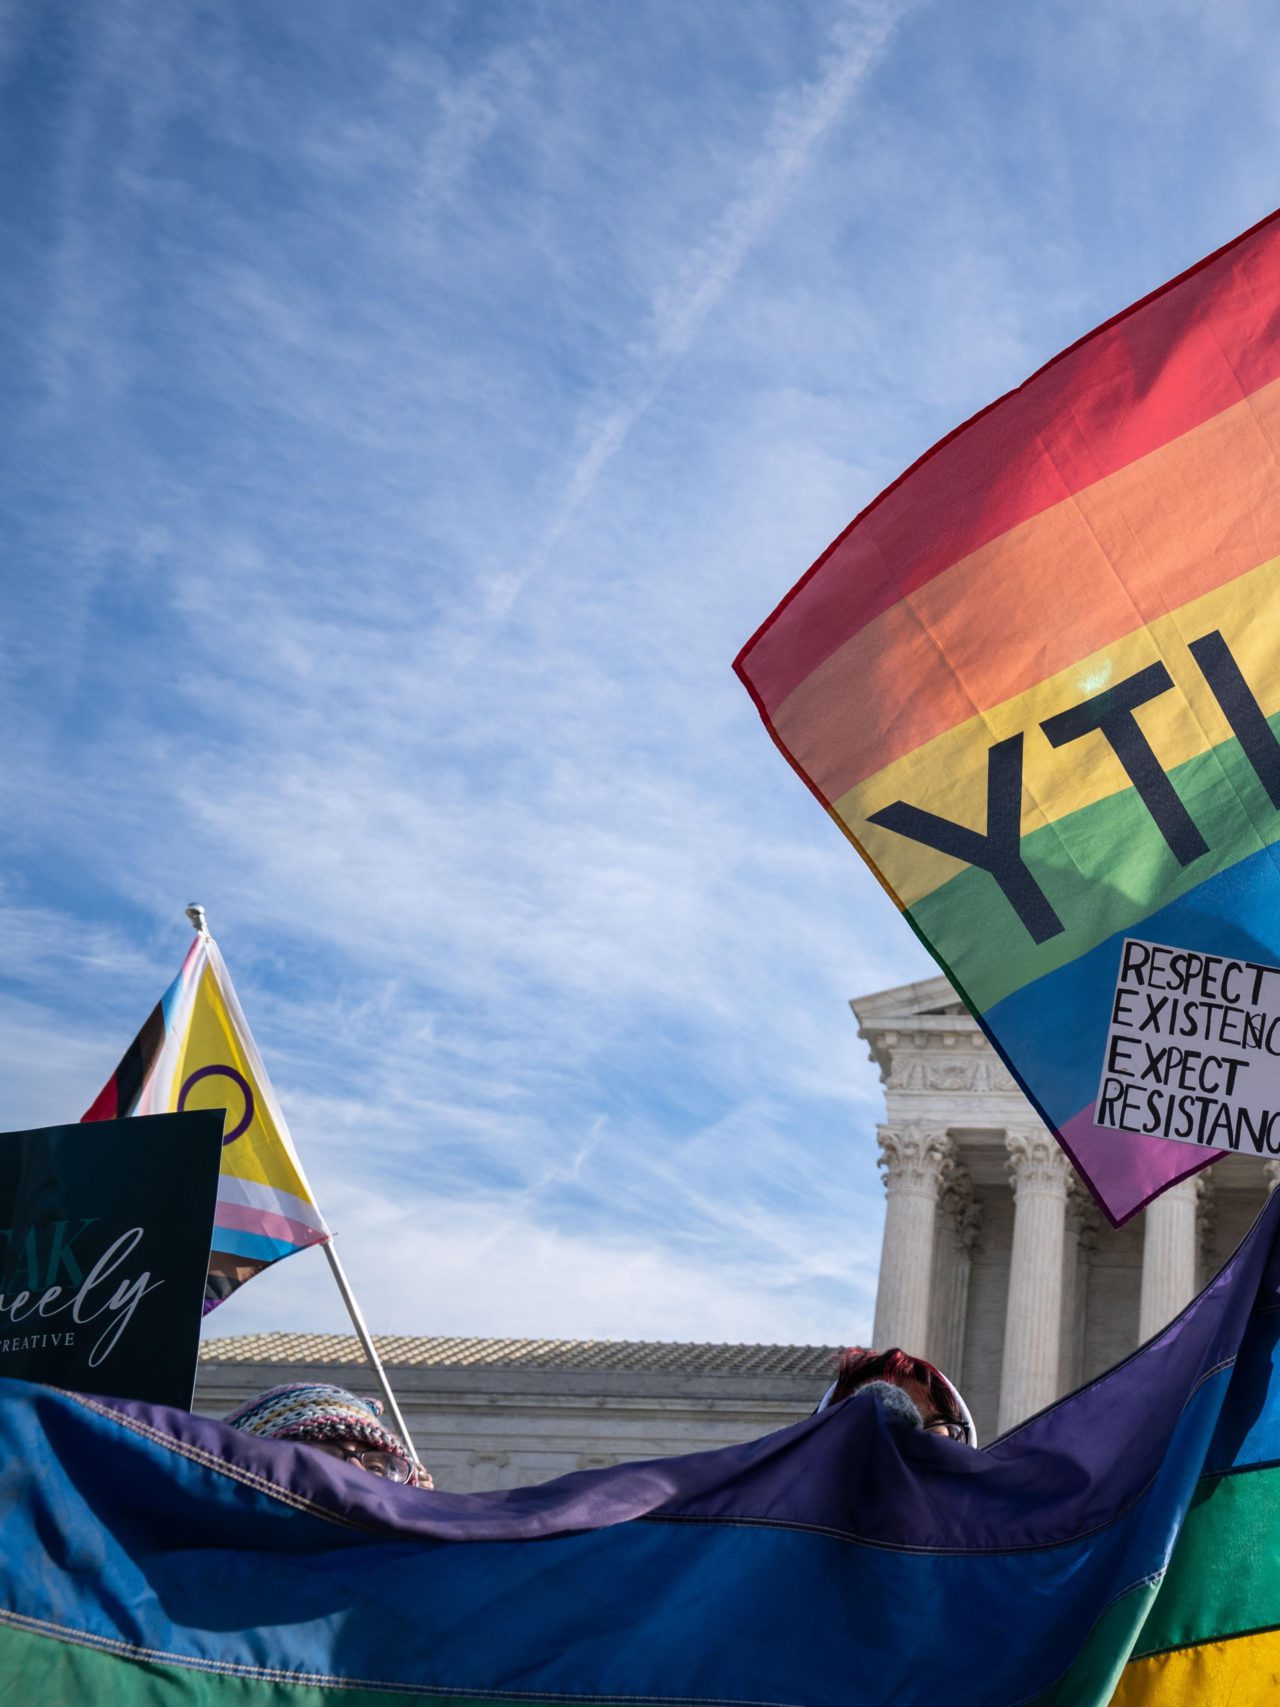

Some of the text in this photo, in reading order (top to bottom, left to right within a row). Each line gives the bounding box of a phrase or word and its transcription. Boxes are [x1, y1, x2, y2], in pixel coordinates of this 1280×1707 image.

[1120, 941, 1280, 1006] RESPECT
[1107, 1034, 1250, 1097] EXPECT
[0, 1332, 76, 1353] REATIVE
